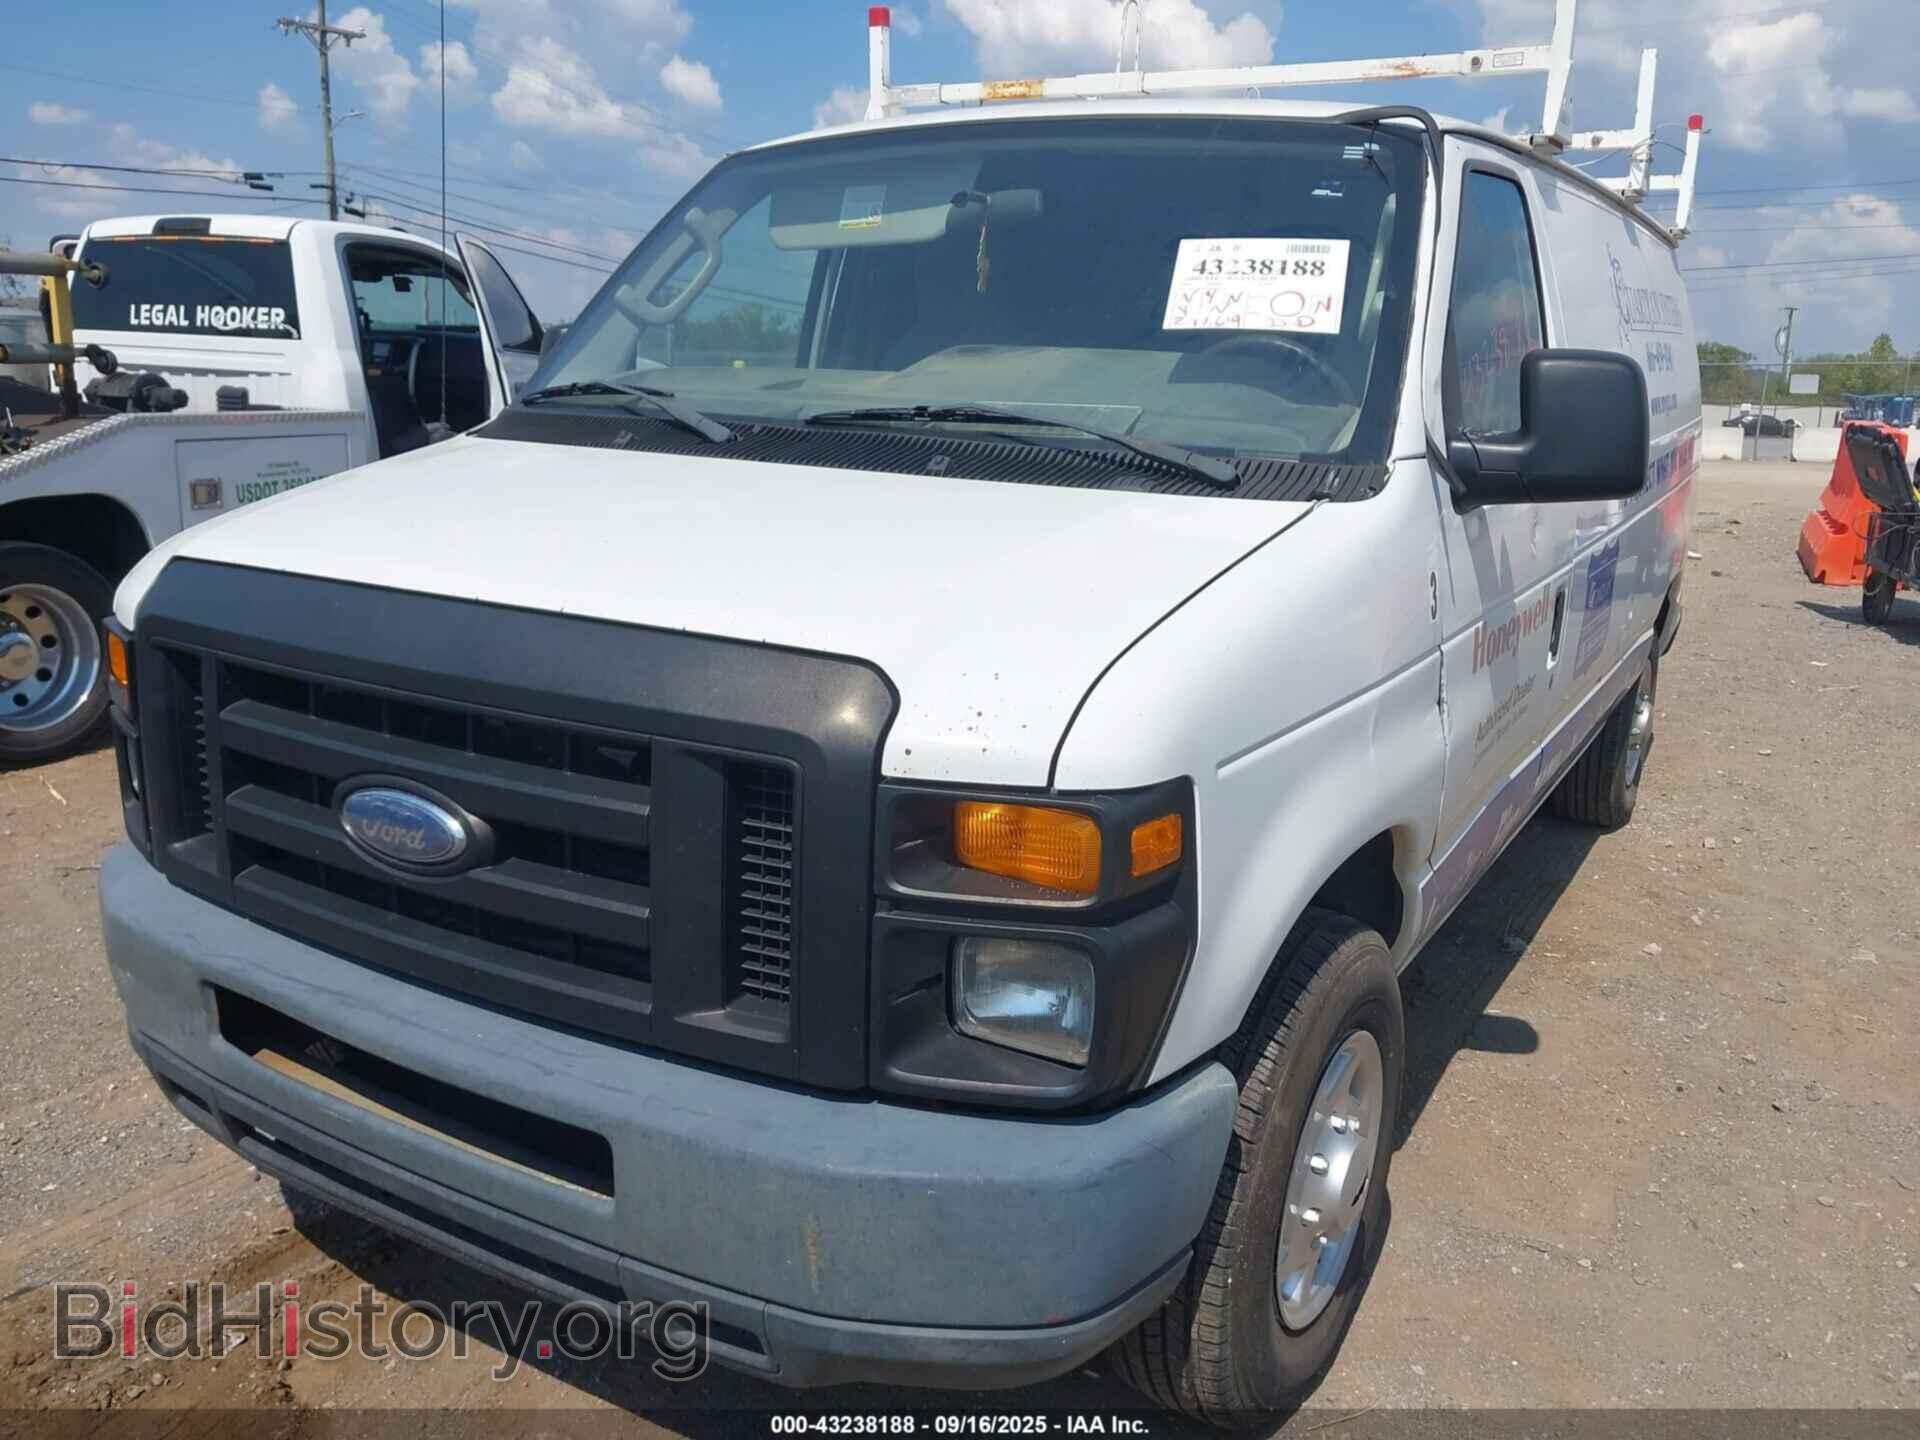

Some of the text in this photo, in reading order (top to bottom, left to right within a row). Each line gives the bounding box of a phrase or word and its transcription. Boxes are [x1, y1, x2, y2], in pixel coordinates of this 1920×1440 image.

[1193, 258, 1326, 277] 43238188
[129, 303, 286, 331] LEGAL HOOKER
[235, 480, 279, 503] USDOT
[1429, 571, 1439, 621] 3
[1472, 584, 1551, 675] Honeywell
[360, 817, 428, 850] Ford
